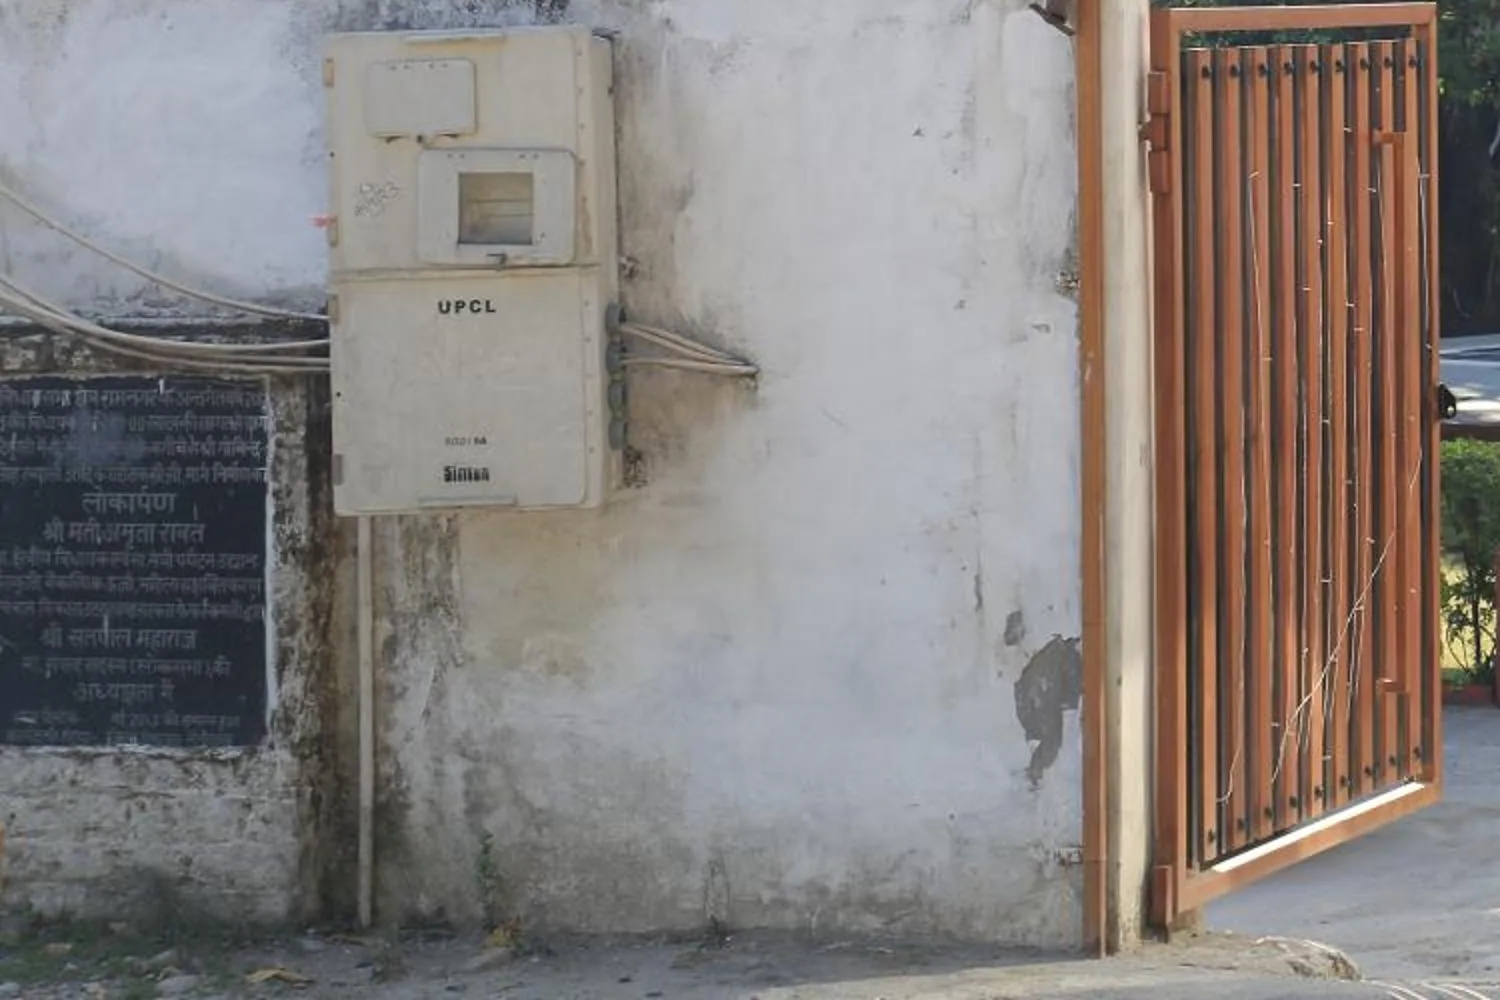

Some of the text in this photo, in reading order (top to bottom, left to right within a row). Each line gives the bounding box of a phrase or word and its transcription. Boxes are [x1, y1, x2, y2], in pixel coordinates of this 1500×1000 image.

[437, 299, 497, 315] UPCL
[82, 485, 178, 516] लोकार्पण
[136, 628, 198, 652] महाराज
